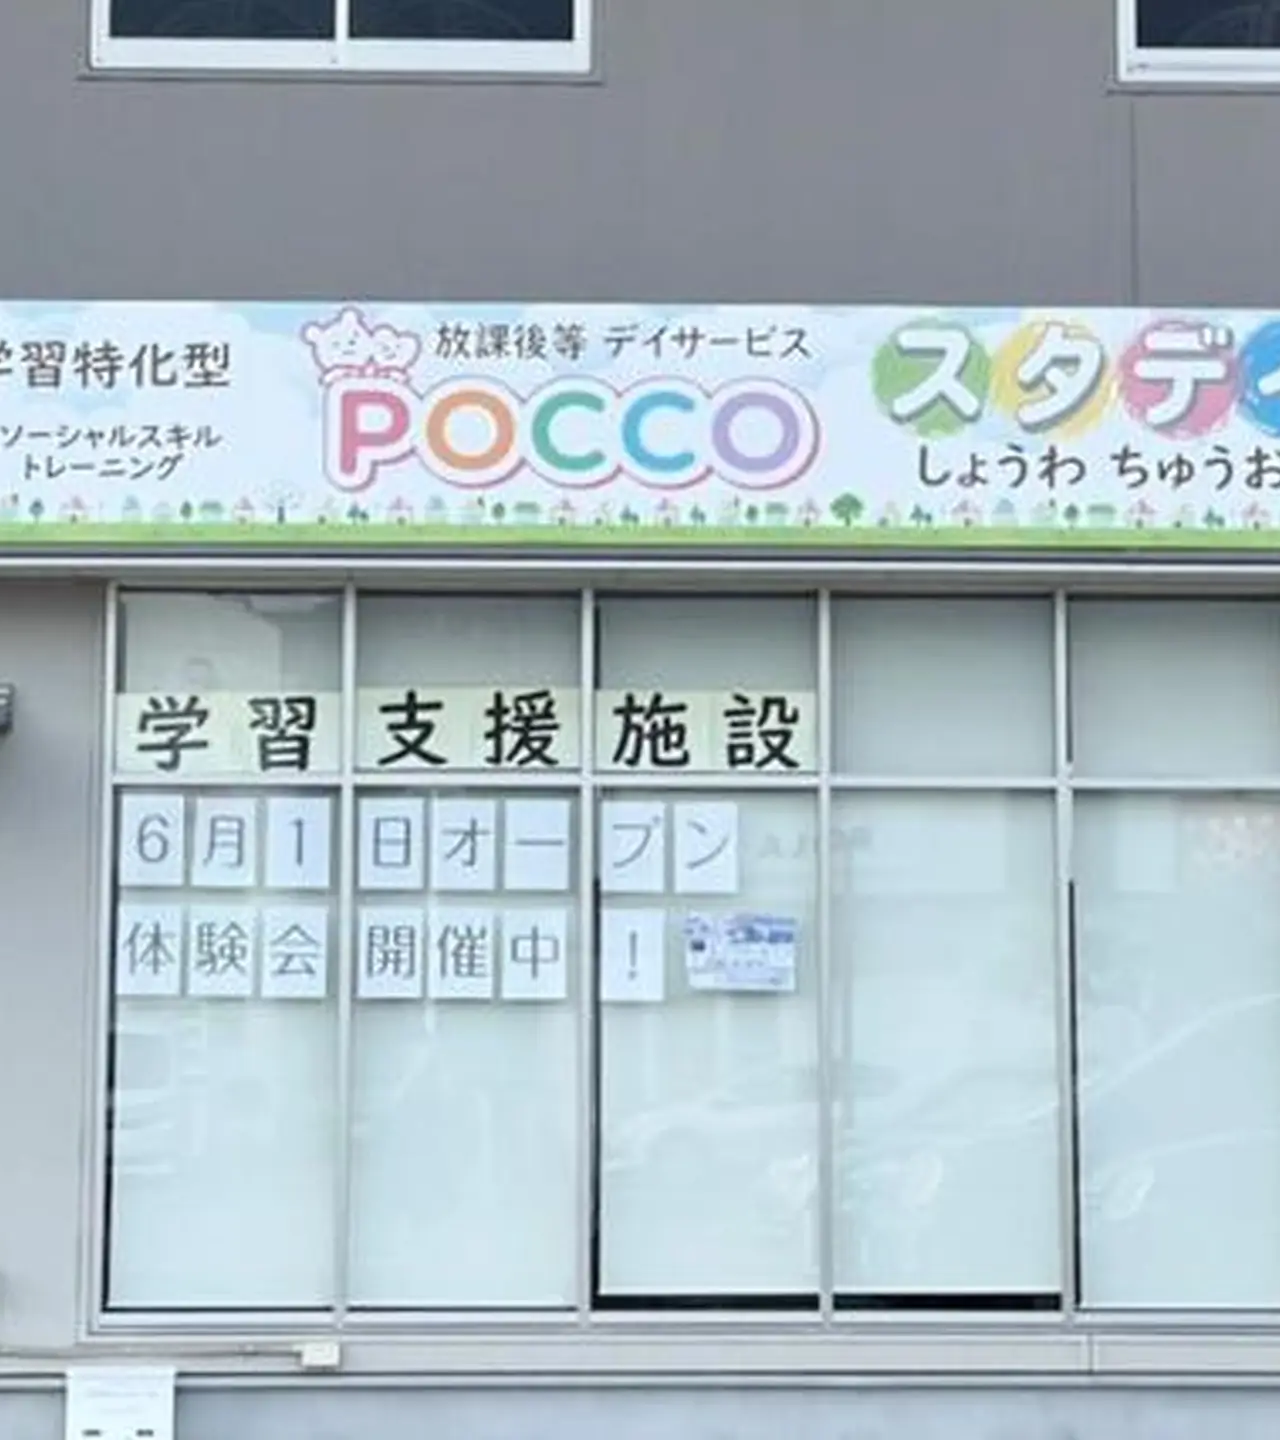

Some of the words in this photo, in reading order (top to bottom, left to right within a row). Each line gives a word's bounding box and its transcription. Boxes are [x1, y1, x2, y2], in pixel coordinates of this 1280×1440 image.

[436, 322, 587, 359] 放課後等
[604, 324, 813, 360] デイサービス
[0, 423, 222, 450] ソーシャルスキル
[340, 389, 801, 474] POCCO
[23, 453, 182, 480] トレーニング
[918, 446, 1087, 488] しょうわ
